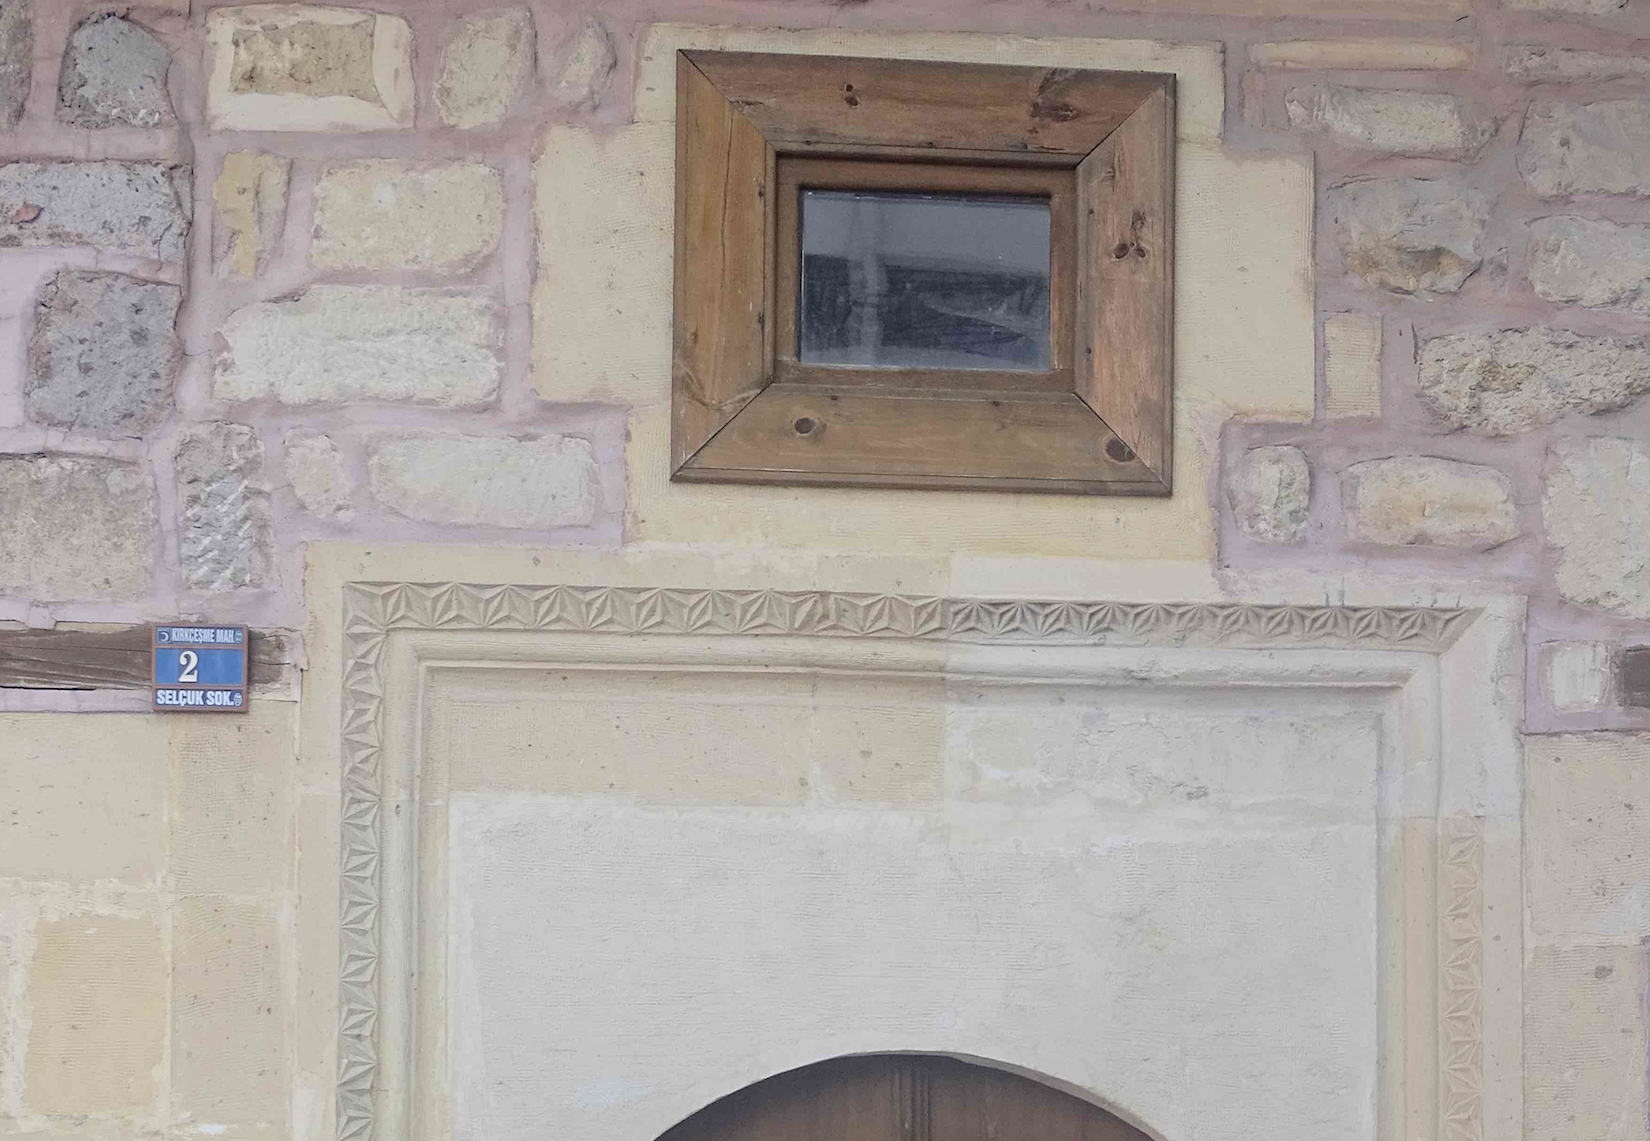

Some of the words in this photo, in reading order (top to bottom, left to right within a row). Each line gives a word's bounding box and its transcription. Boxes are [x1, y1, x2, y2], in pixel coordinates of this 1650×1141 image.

[171, 628, 215, 643] KIRKÇEŞME
[179, 651, 199, 682] 2
[156, 690, 204, 706] SELÇUK
[206, 690, 234, 706] SOK.
